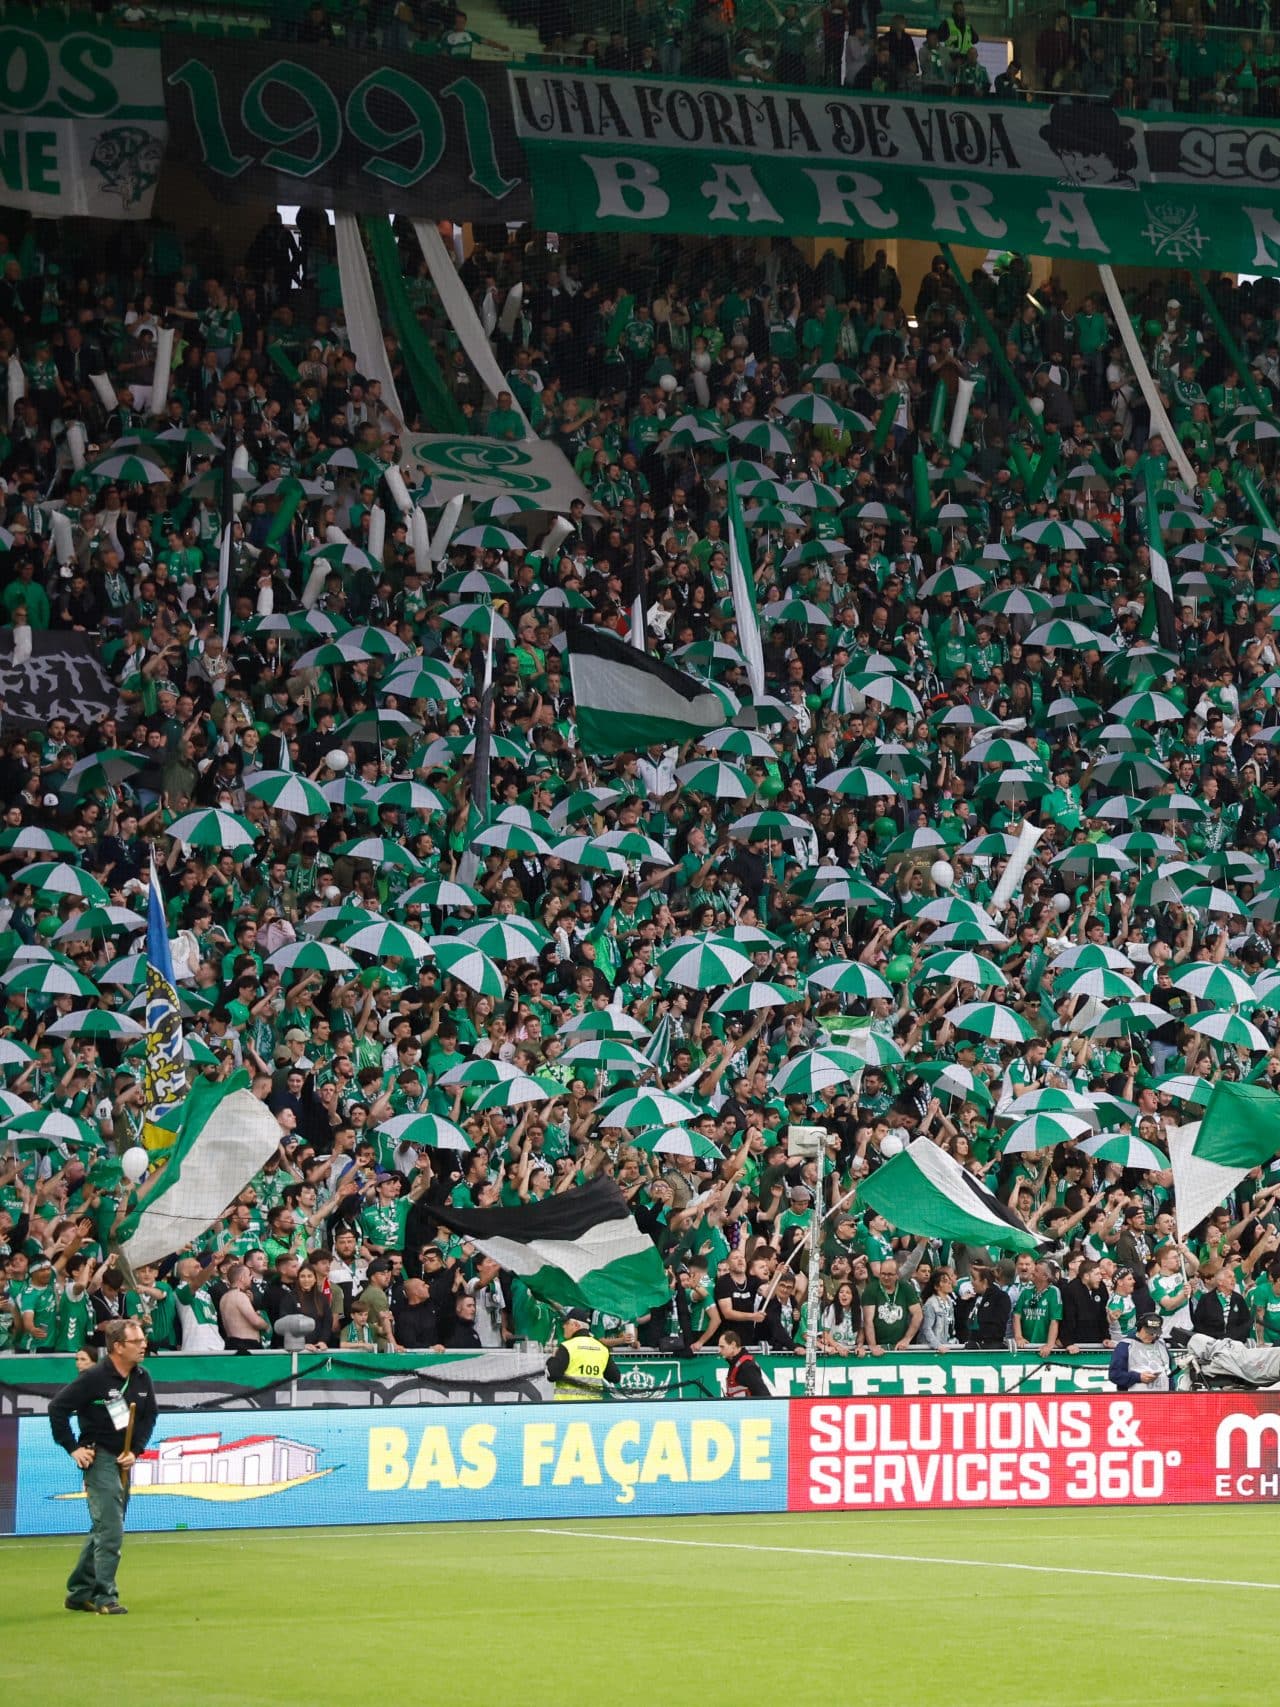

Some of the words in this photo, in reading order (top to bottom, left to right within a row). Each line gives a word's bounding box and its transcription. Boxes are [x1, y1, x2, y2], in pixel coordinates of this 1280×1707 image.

[168, 59, 521, 199] 1991
[633, 86, 822, 152] FORMA
[831, 103, 899, 160] DE
[904, 107, 1021, 169] VIDA
[581, 154, 1111, 254] BARRA
[578, 1364, 600, 1376] 109
[368, 1424, 497, 1491] BAS
[523, 1419, 772, 1503] FAÇADE
[810, 1402, 1091, 1452] SOLUTIONS
[1107, 1401, 1143, 1447] &
[810, 1452, 1051, 1504] SERVICES
[1067, 1451, 1181, 1500] 360°
